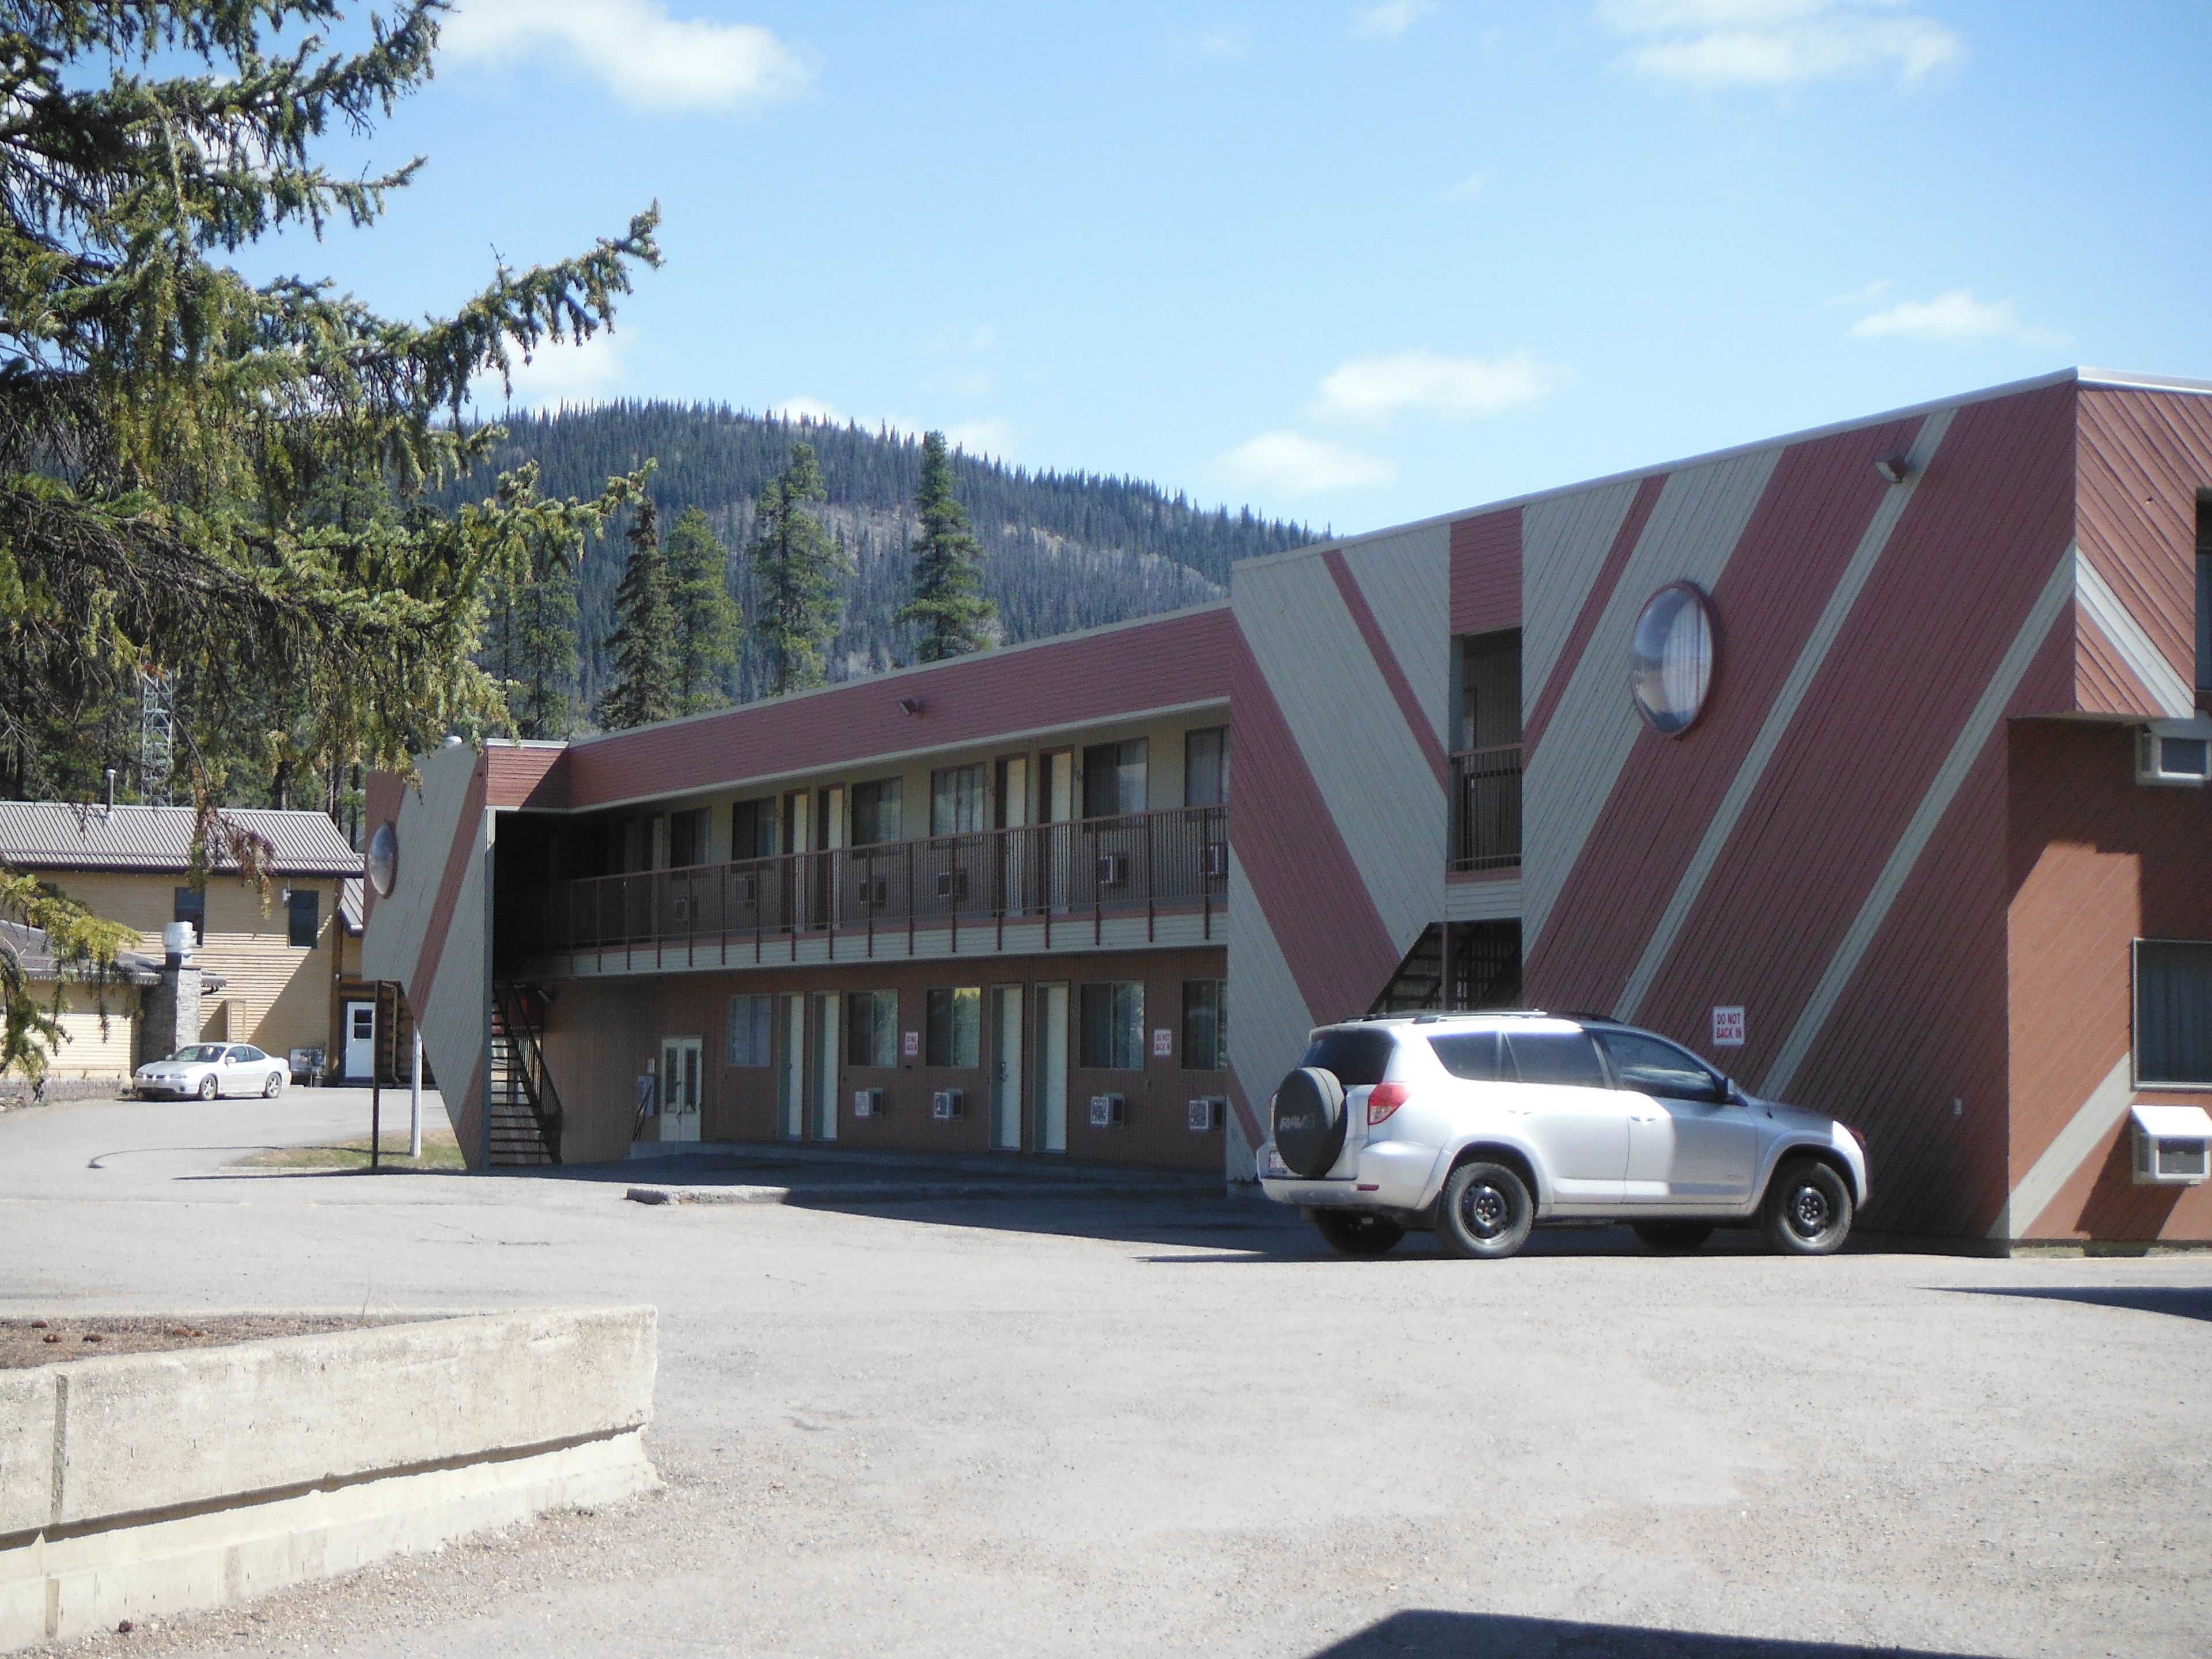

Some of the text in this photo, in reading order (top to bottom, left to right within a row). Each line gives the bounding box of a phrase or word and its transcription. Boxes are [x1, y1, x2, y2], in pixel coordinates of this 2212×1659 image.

[1717, 1013, 1740, 1024] DO NOT
[1717, 1027, 1742, 1038] BACK IN
